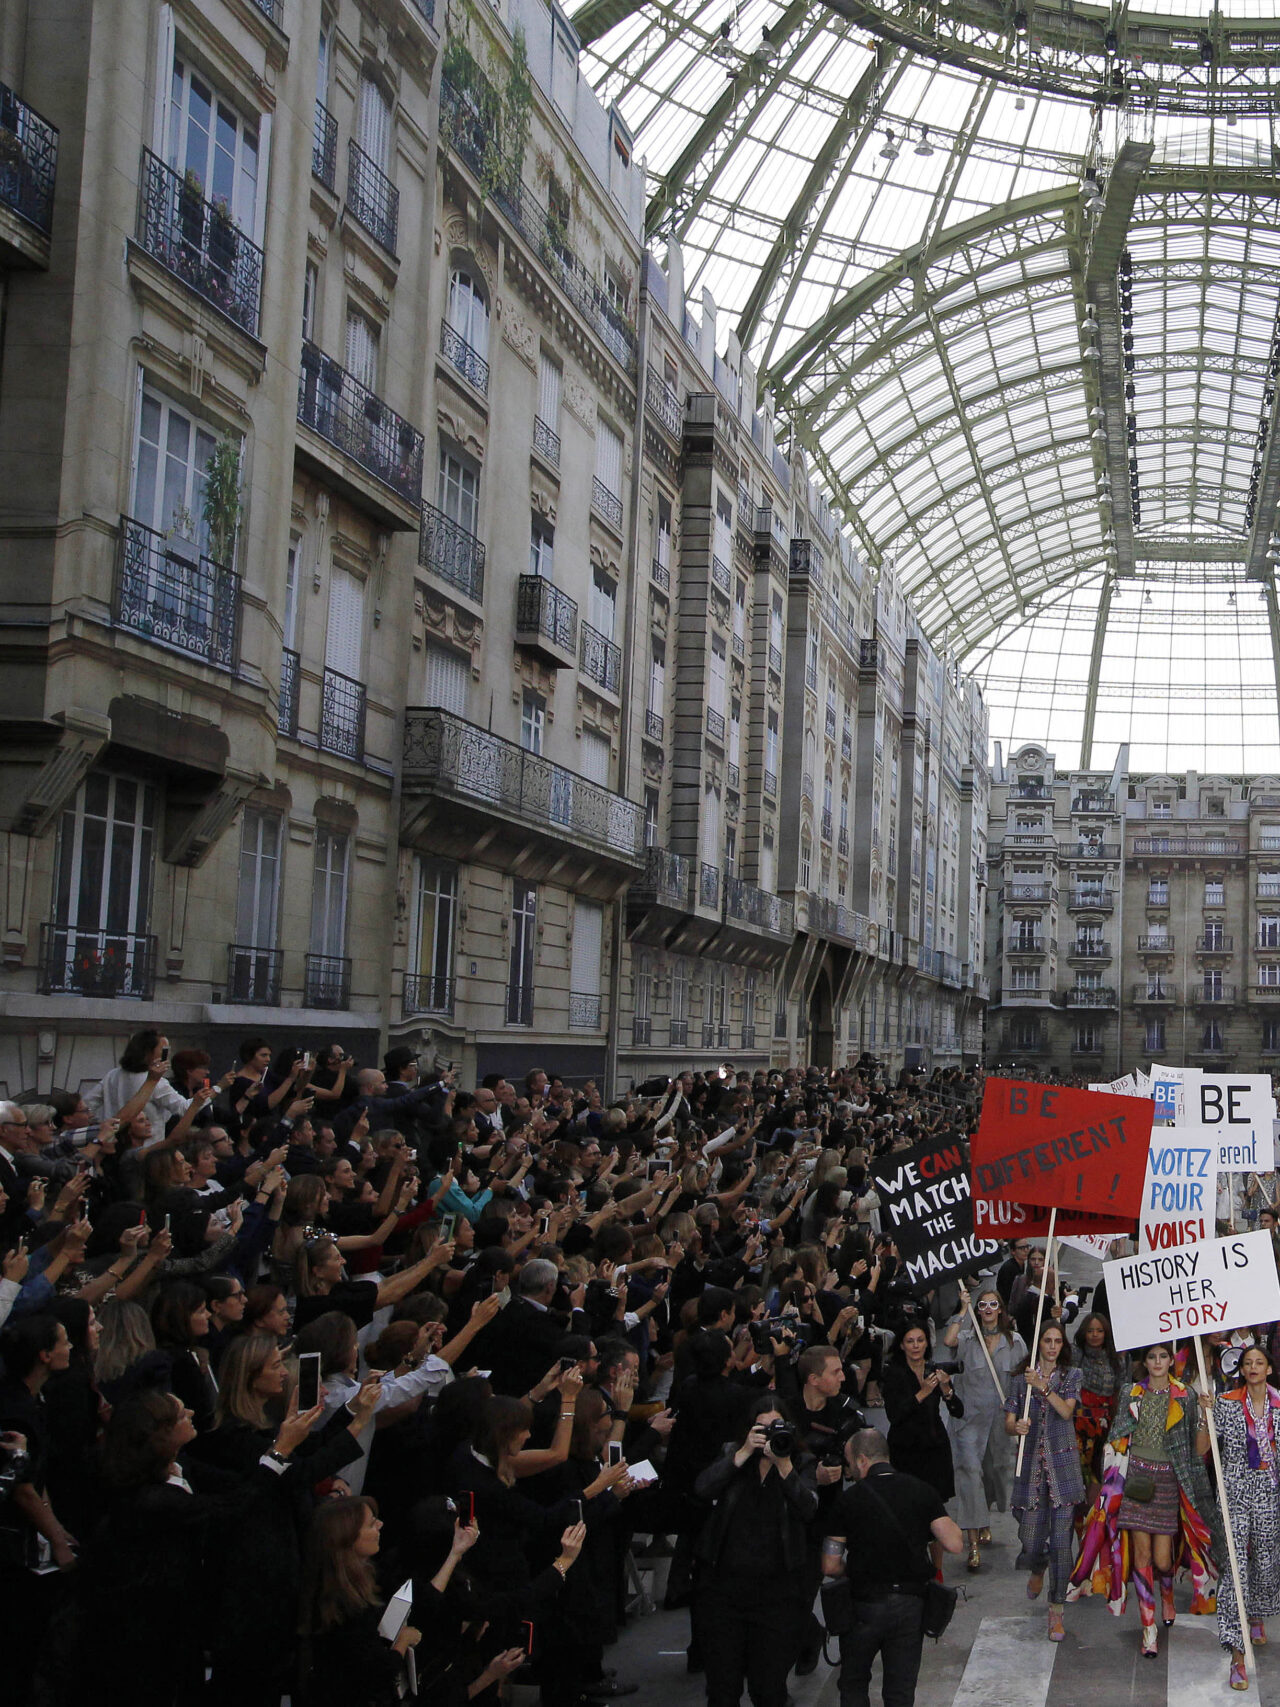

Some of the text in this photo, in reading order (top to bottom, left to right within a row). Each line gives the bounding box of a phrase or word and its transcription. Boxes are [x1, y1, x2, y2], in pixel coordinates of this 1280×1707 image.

[1111, 1078, 1129, 1094] BOYS
[1009, 1087, 1059, 1119] BE
[1200, 1085, 1252, 1124] BE
[875, 1145, 962, 1195] WE CAN
[974, 1116, 1127, 1193] DIFFERENT
[1149, 1147, 1212, 1177] VOTEZ
[889, 1173, 971, 1226] MATCH
[1150, 1182, 1204, 1212] POUR
[922, 1212, 956, 1237] THE
[905, 1232, 1000, 1285] MACHOS
[1120, 1242, 1249, 1290] HISTORY IS
[1169, 1278, 1216, 1306] HER
[1159, 1301, 1228, 1333] STORY
